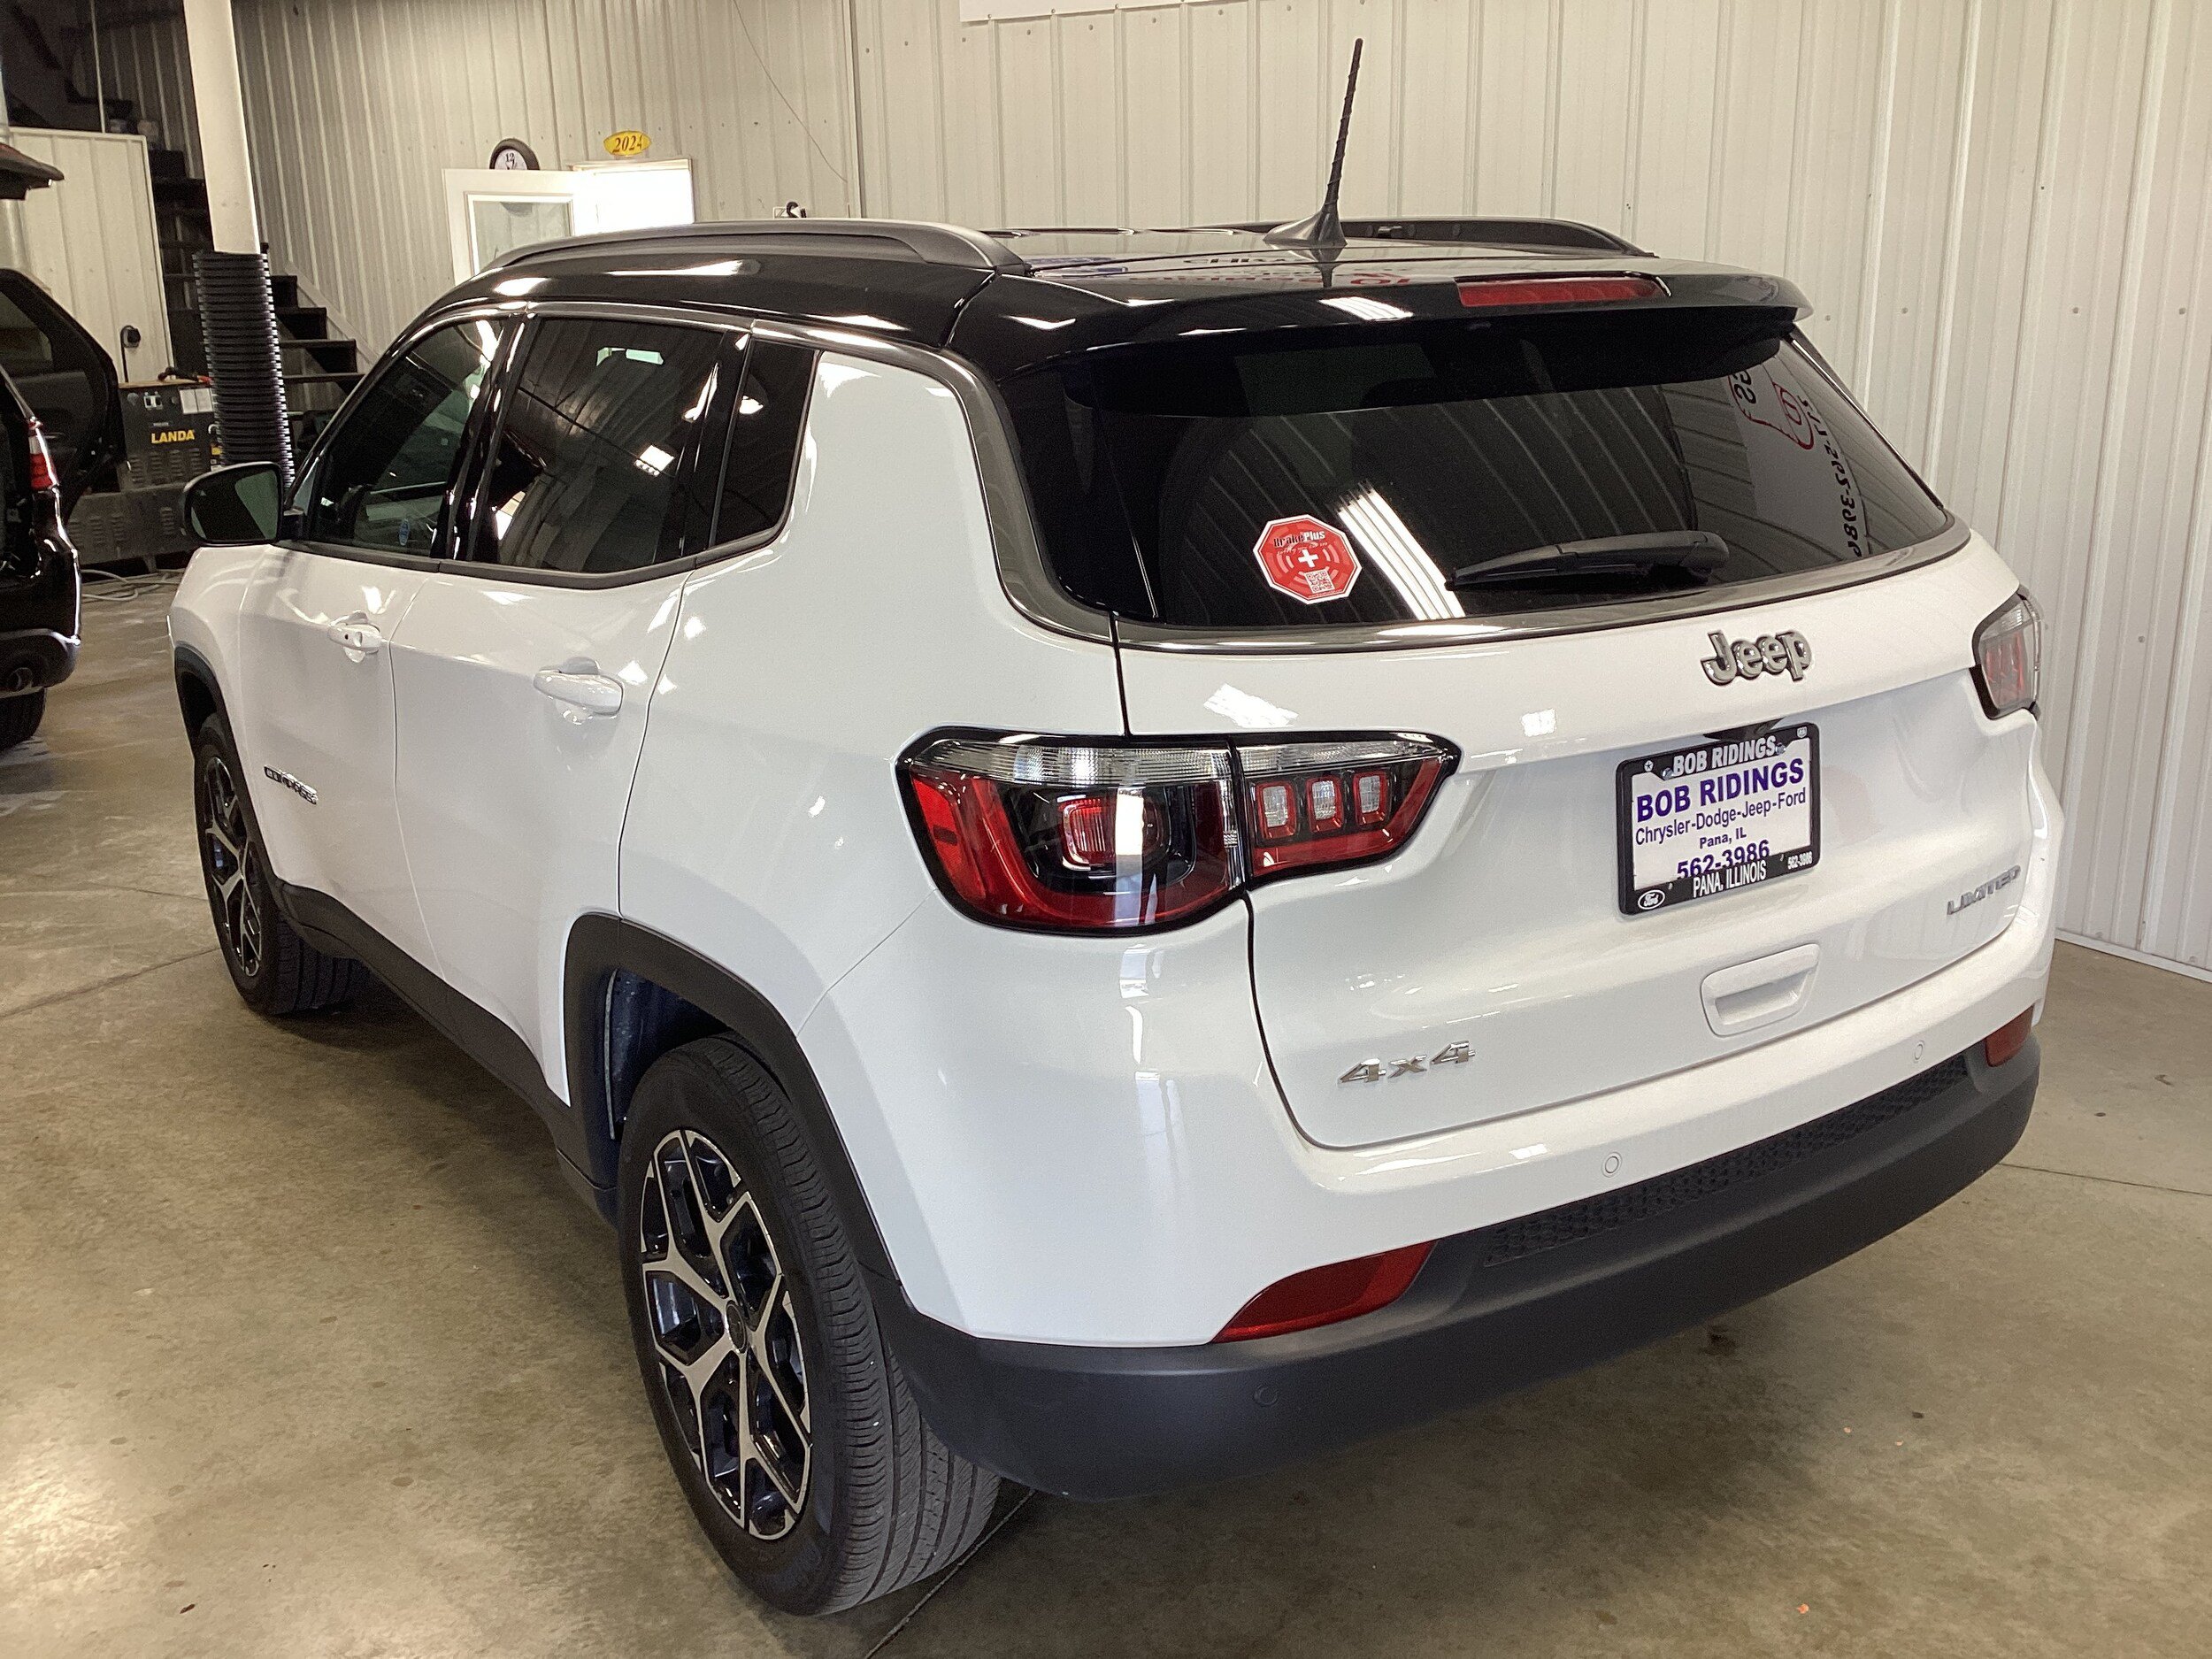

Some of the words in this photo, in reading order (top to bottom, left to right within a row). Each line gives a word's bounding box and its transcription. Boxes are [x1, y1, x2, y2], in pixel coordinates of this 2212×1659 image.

[505, 152, 515, 162] 12
[612, 134, 643, 153] 2024
[150, 429, 196, 444] LANDA
[1701, 629, 1813, 687] Jeep
[1672, 750, 1708, 777] BOB
[1711, 735, 1777, 769] RIDINGS
[1636, 784, 1691, 822] BOB
[1700, 757, 1804, 807] RIDINGS
[1635, 787, 1807, 846] Chrysler-Dodge-Jeep-Ford
[1699, 833, 1732, 849] Pana,
[1736, 826, 1747, 840] IL
[1677, 839, 1770, 879] 562-3986
[1725, 860, 1767, 889] ILLINOIS
[1947, 864, 2022, 916] LIMITED
